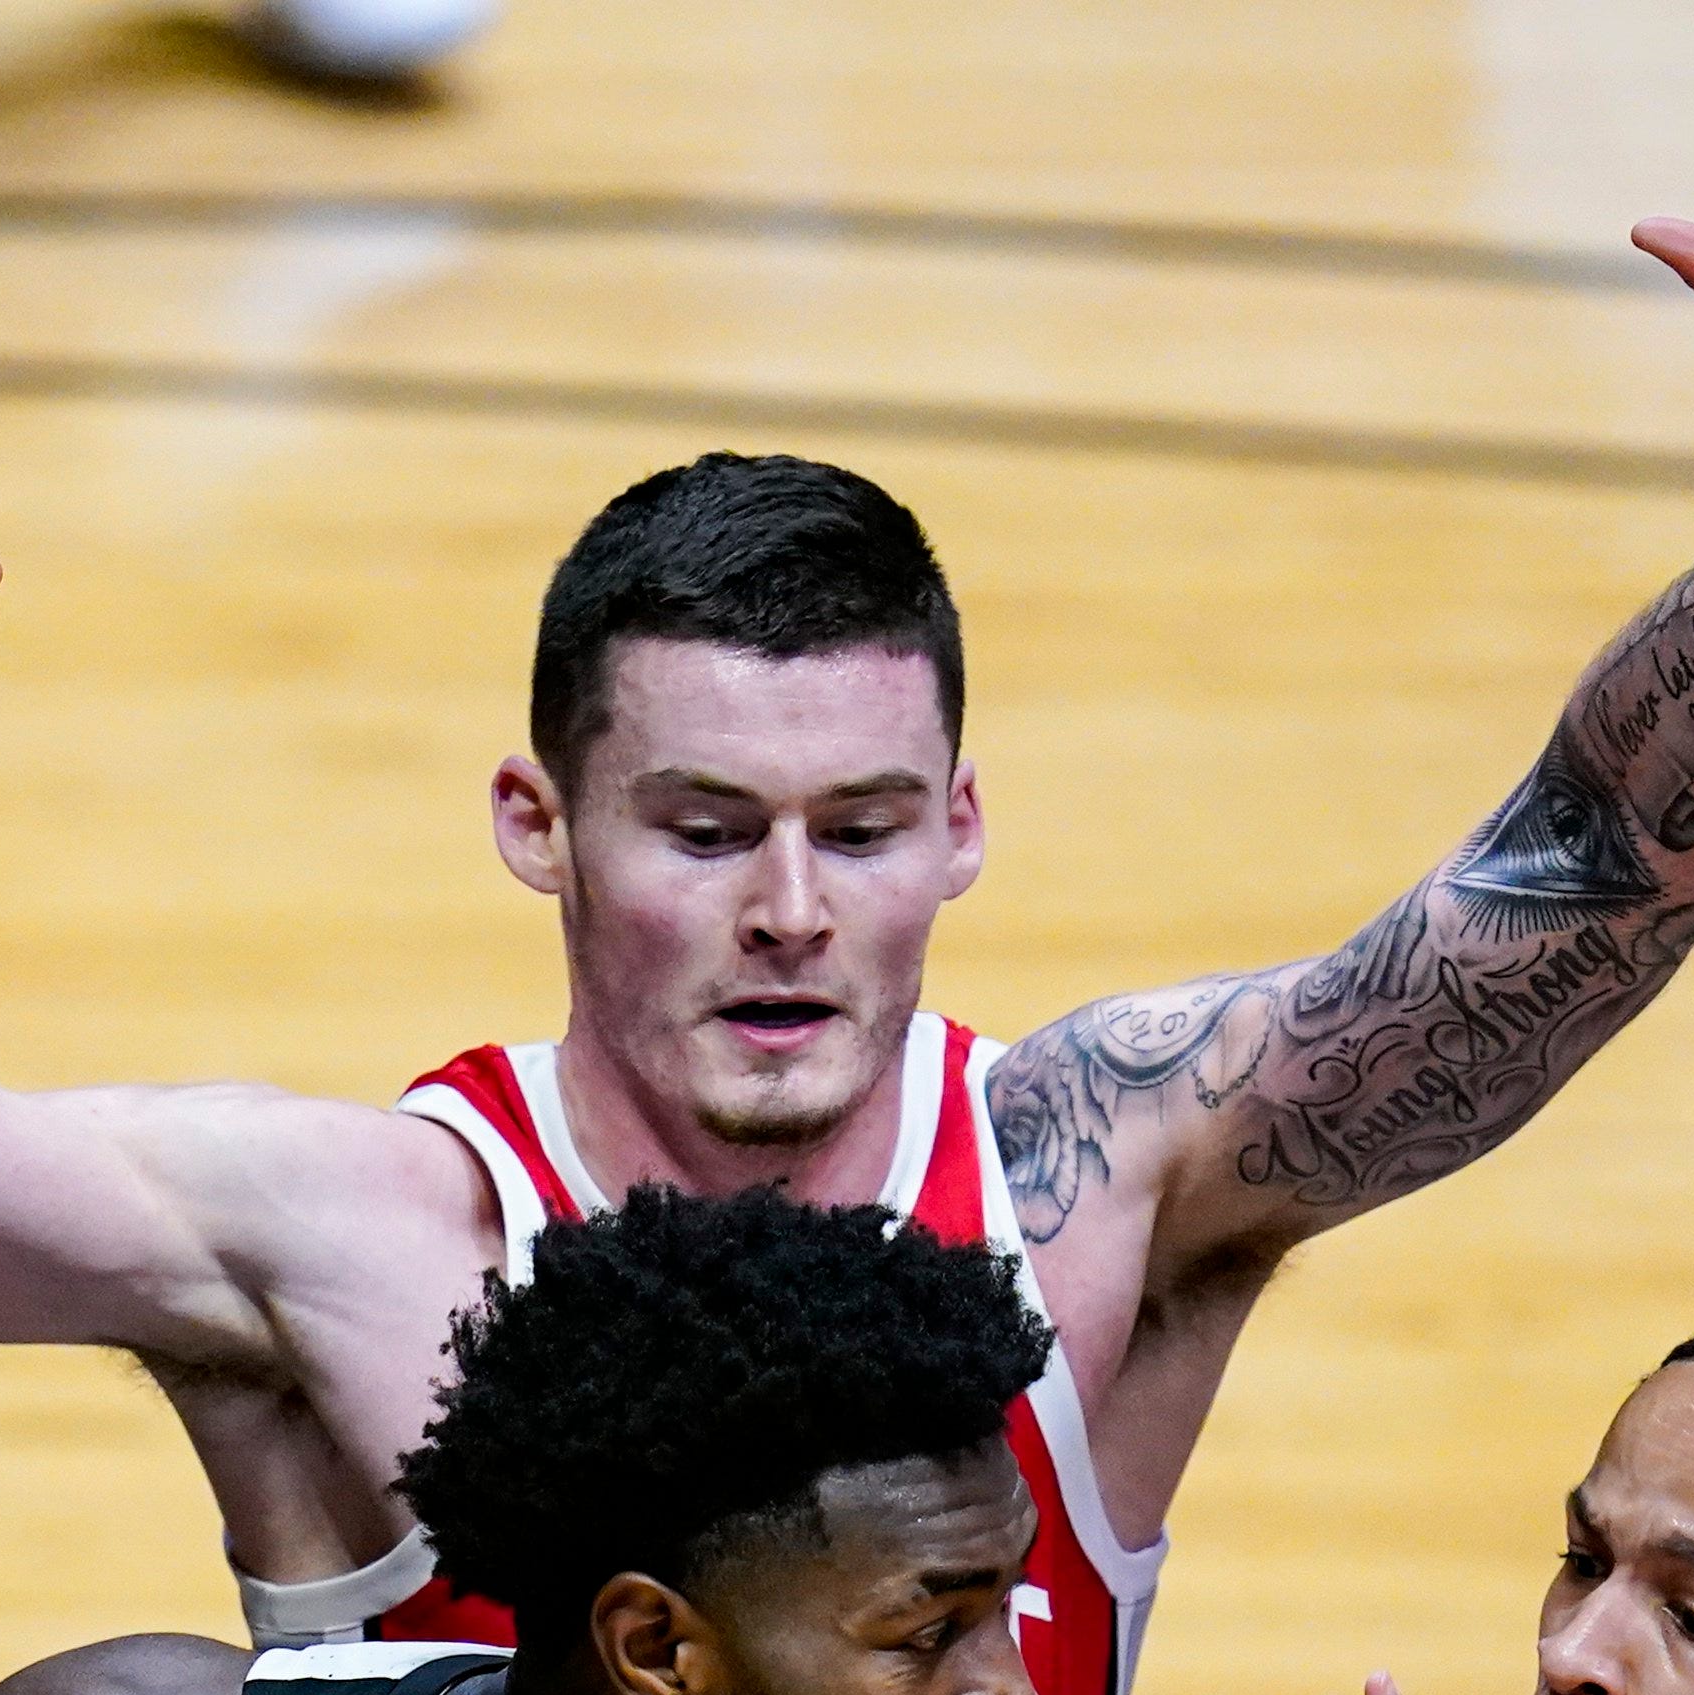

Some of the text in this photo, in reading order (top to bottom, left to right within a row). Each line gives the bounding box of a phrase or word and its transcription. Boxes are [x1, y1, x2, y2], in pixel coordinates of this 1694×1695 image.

[1585, 690, 1661, 778] Never
[1237, 923, 1637, 1203] Young Strong
